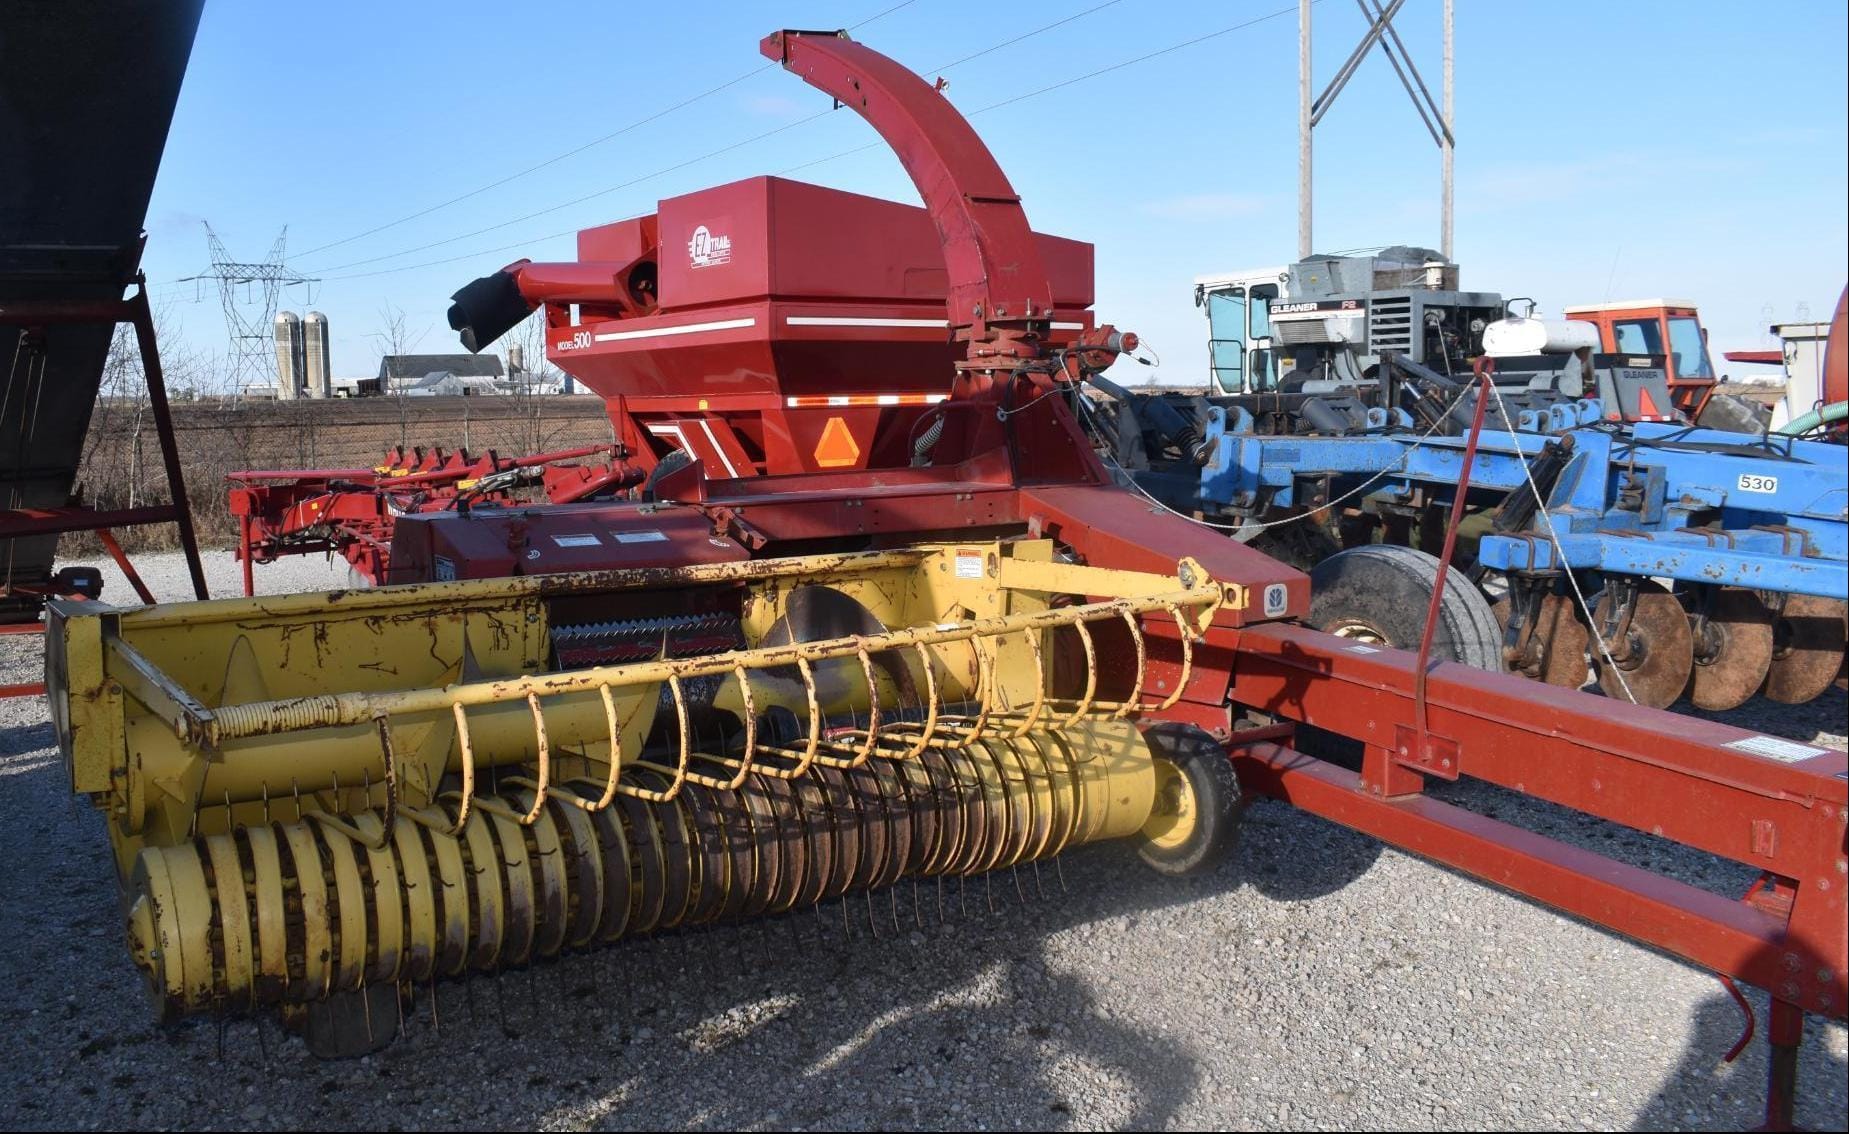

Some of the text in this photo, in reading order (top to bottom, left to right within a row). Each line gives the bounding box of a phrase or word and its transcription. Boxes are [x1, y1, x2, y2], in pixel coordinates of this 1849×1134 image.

[710, 236, 731, 252] TRAIL
[1271, 303, 1318, 313] GLEANER
[558, 331, 591, 350] MODEL 500
[1623, 370, 1658, 379] GLEANER
[1741, 477, 1775, 490] 530
